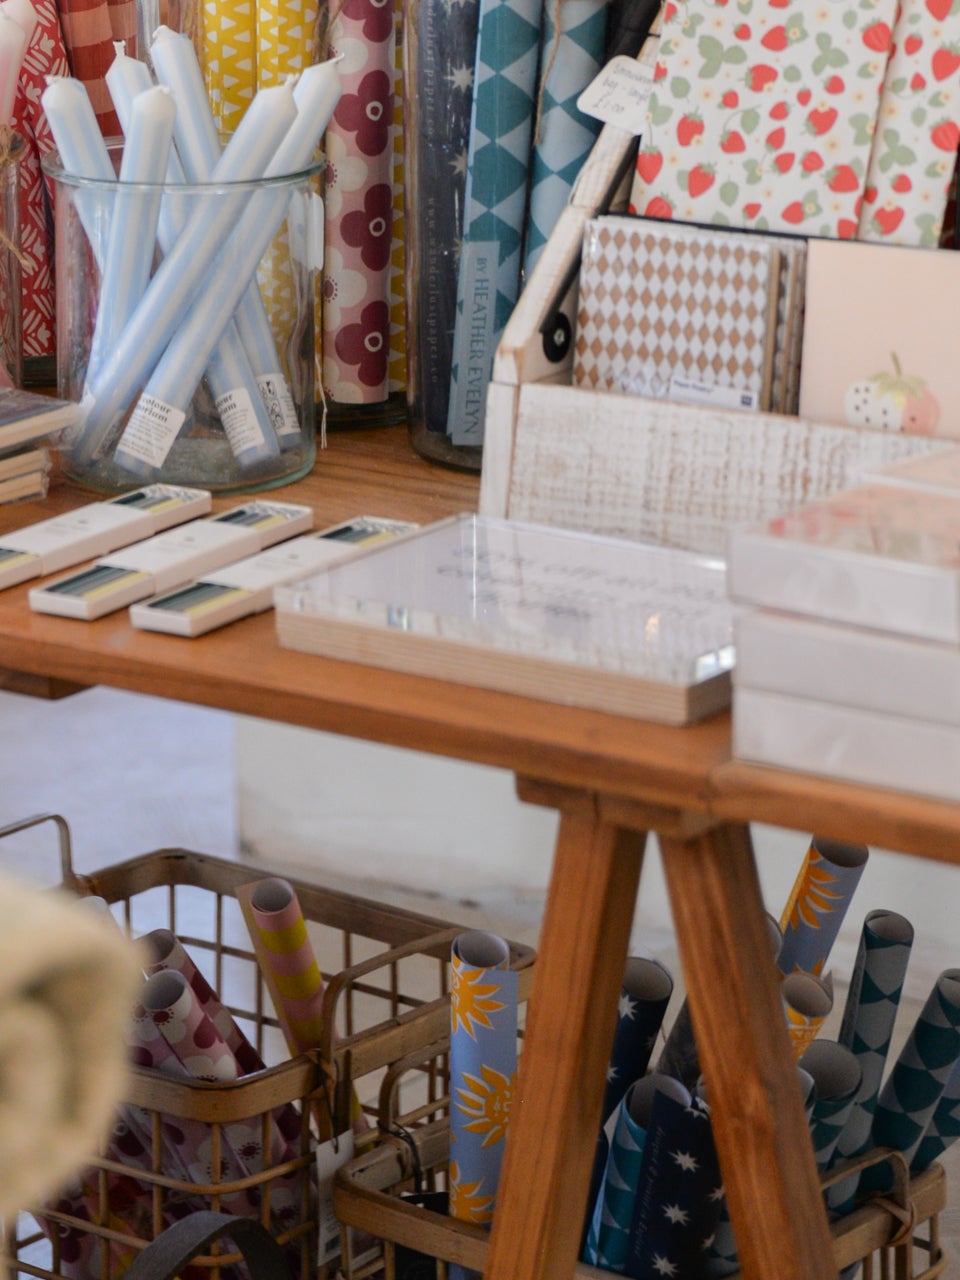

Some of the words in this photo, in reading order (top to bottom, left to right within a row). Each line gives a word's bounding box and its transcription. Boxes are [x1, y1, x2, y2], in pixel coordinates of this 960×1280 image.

[423, 69, 435, 111] paper
[475, 256, 488, 275] BY
[468, 276, 490, 361] HEATHER
[462, 369, 484, 435] EVELYN
